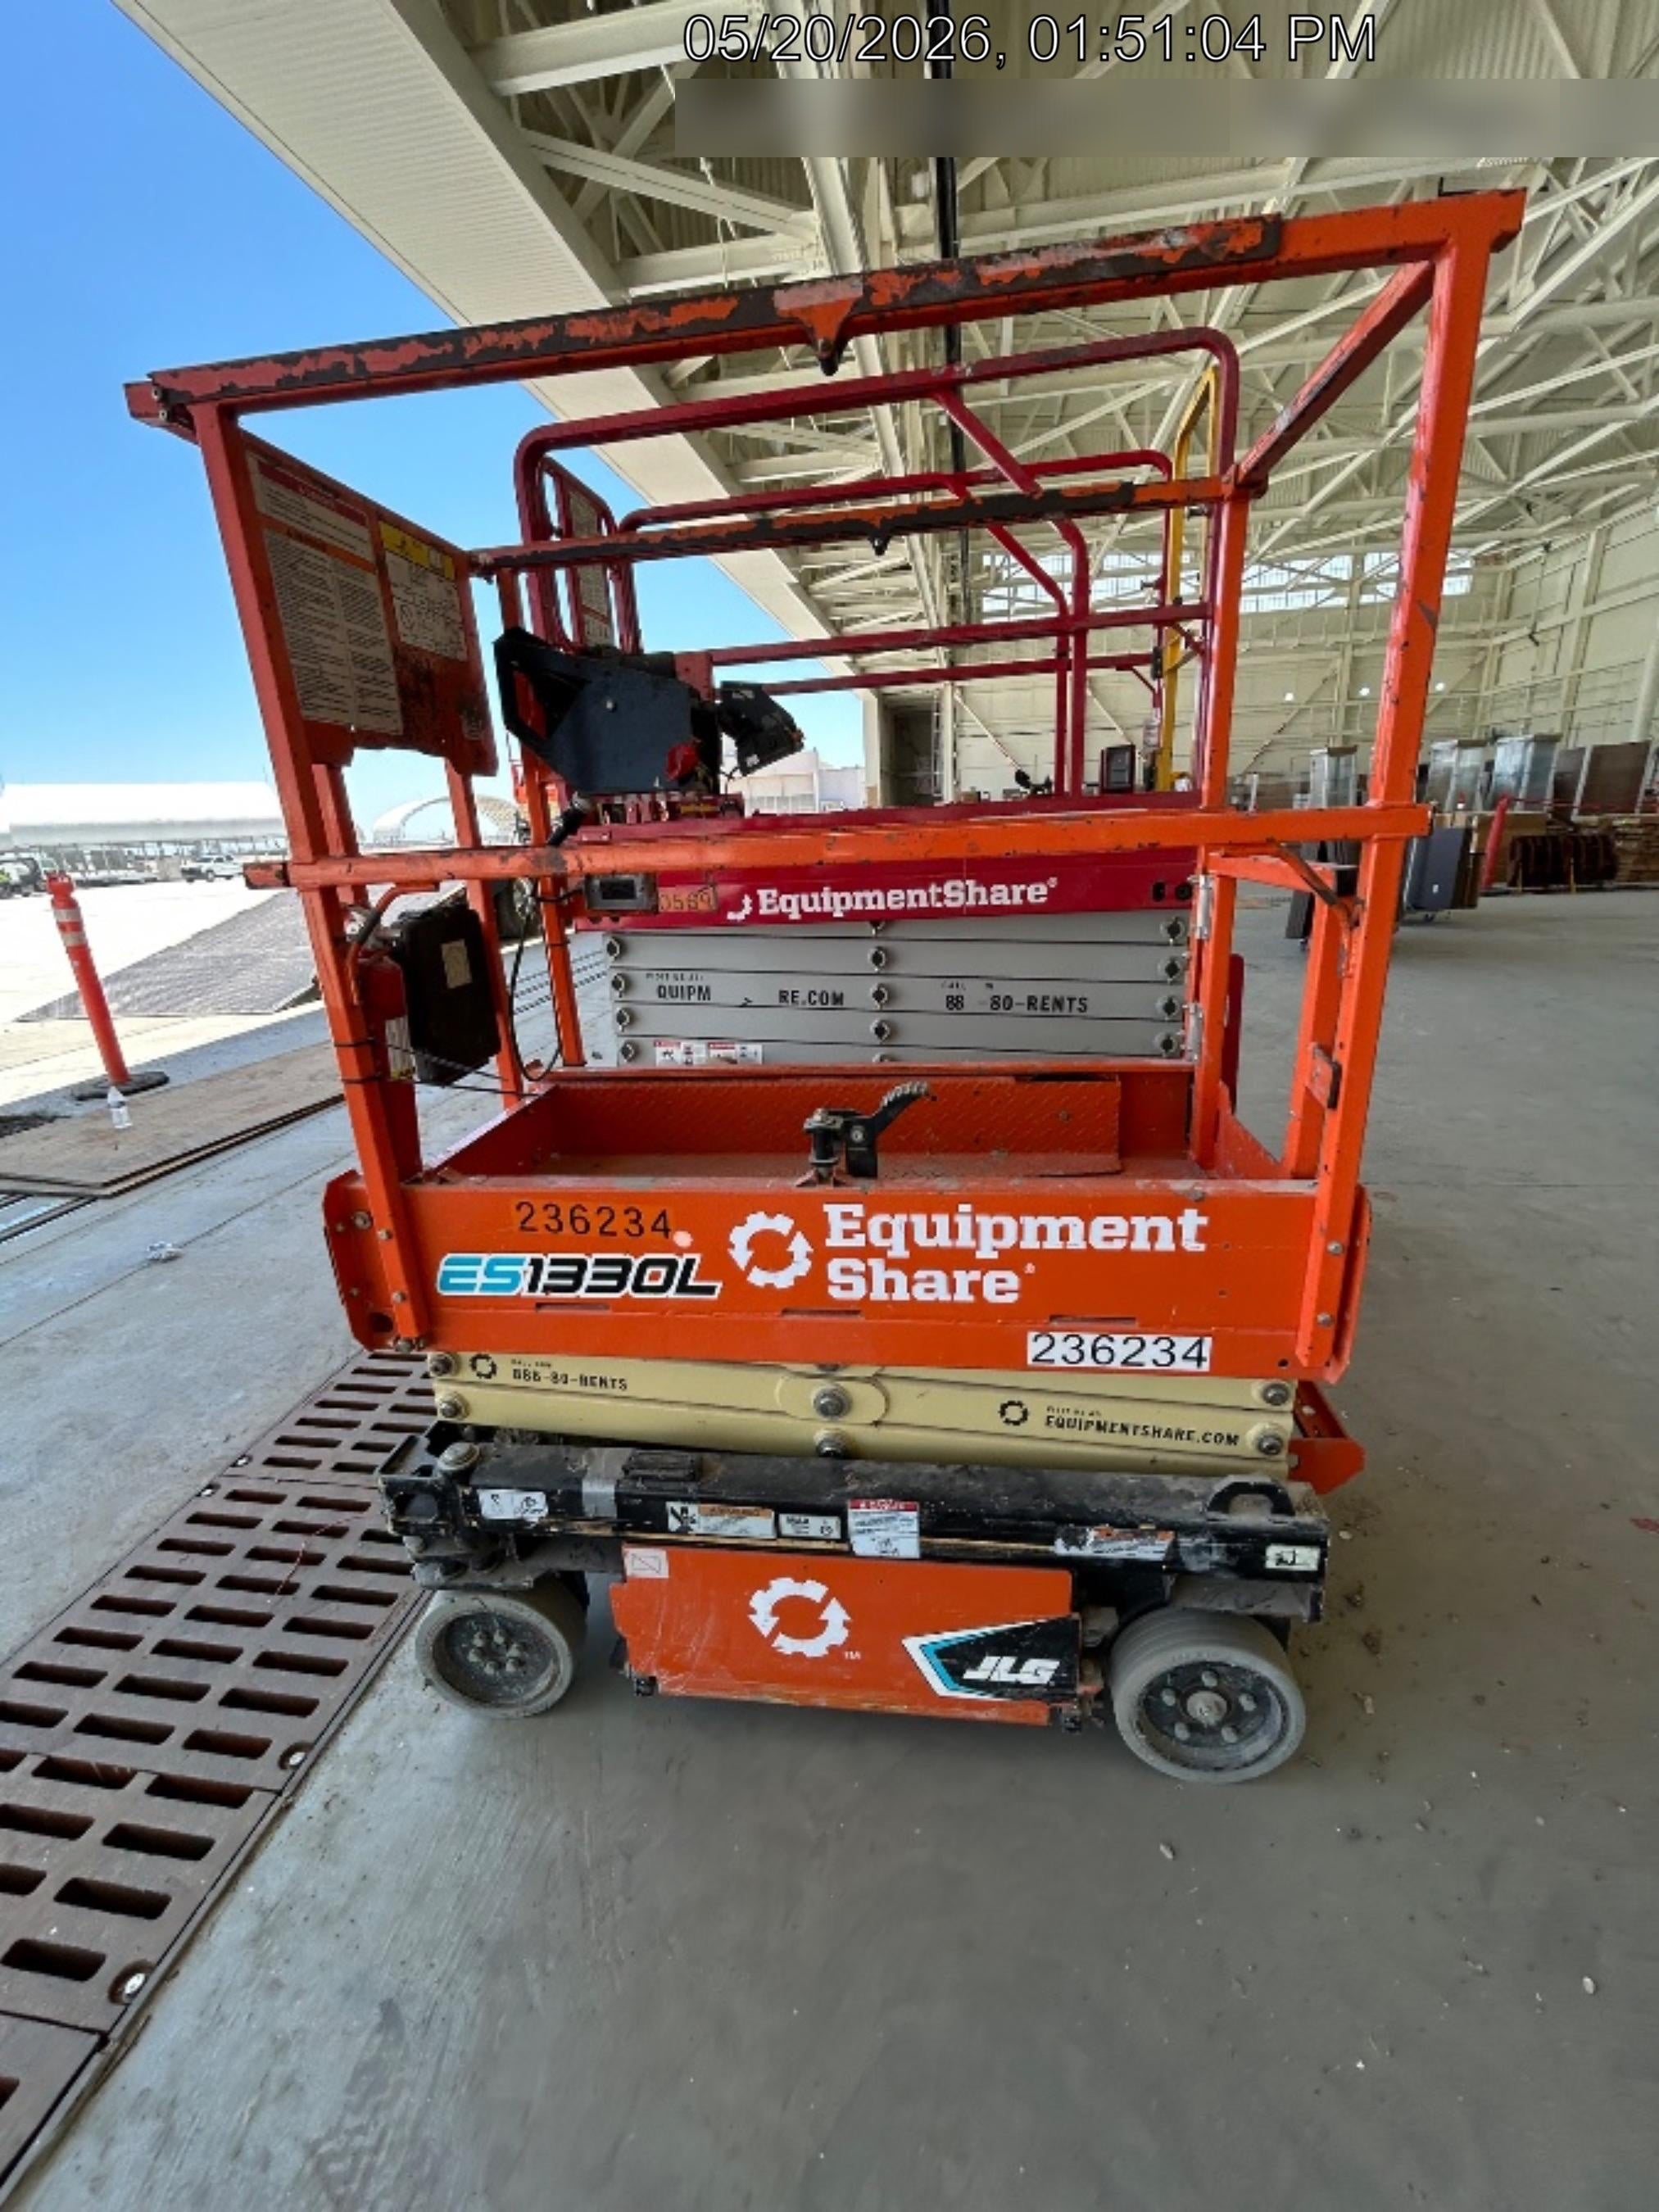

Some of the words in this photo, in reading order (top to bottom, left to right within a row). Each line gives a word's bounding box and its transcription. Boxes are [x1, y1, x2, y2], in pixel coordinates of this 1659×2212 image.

[515, 1201, 671, 1240] 236234
[822, 1203, 1209, 1259] Equipment
[437, 1253, 723, 1299] ES1330L
[1031, 1333, 1208, 1369] 236234
[963, 1655, 1060, 1684] JLG
